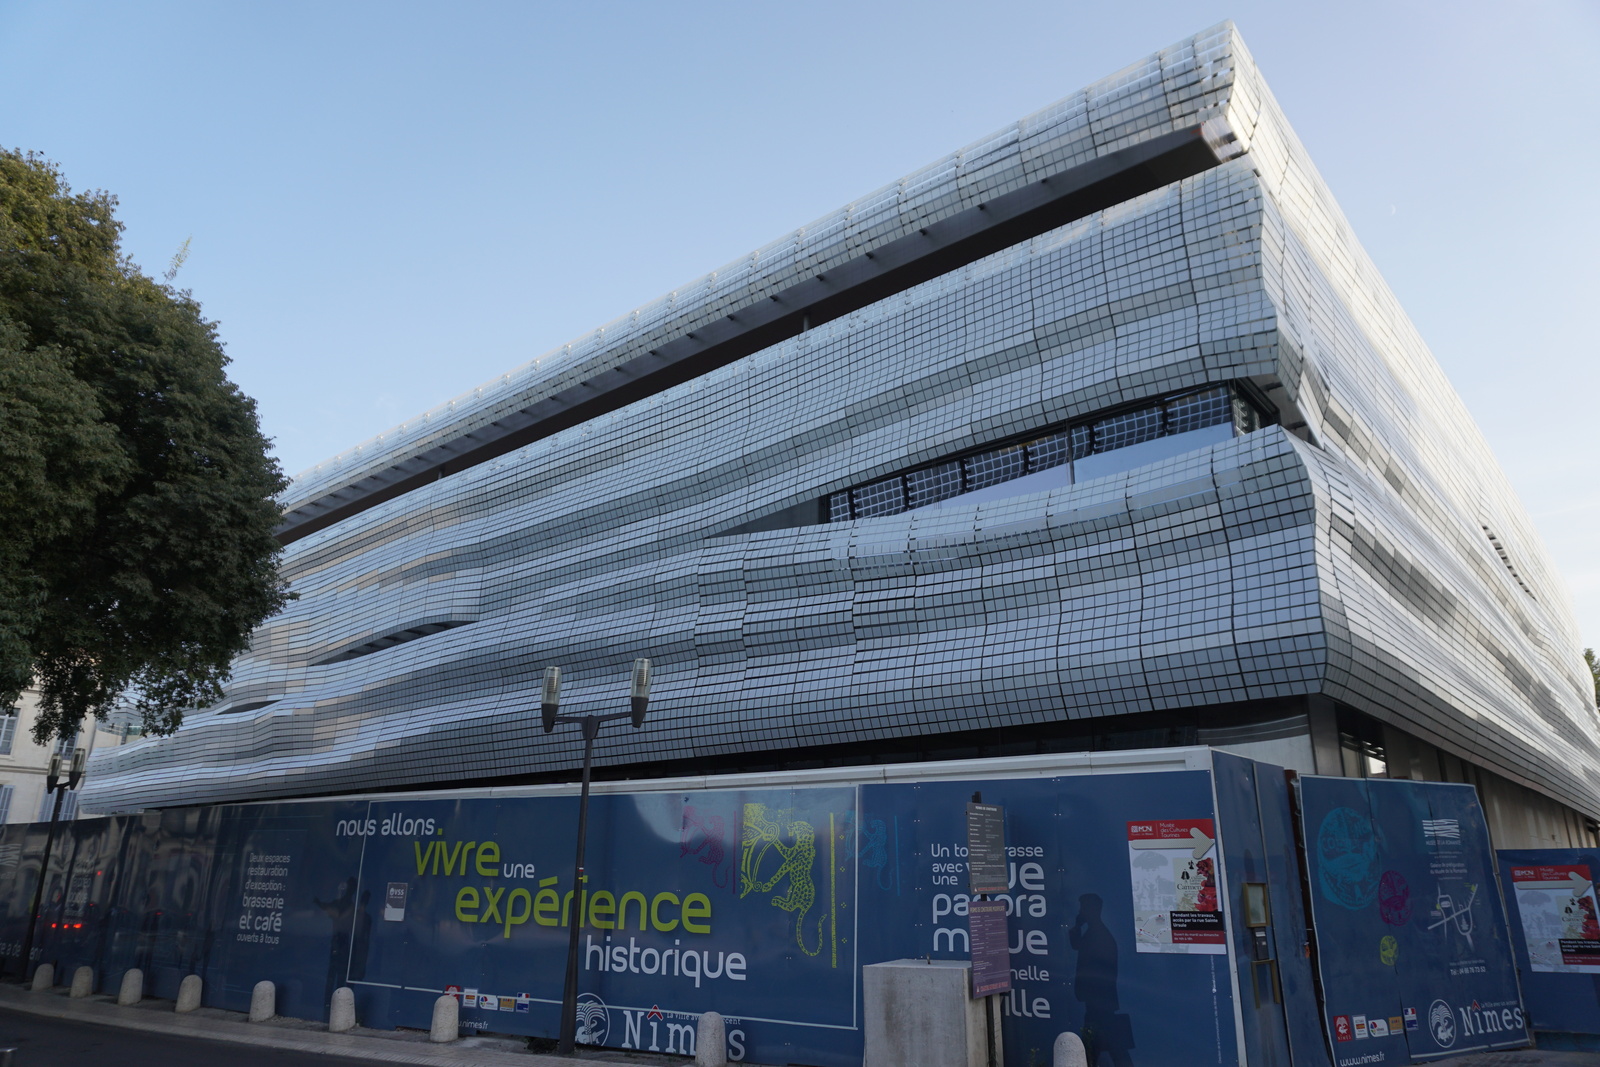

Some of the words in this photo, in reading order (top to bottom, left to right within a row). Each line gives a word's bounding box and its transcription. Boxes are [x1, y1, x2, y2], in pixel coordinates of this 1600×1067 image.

[336, 818, 376, 837] nous
[380, 813, 436, 836] allons
[249, 852, 264, 863] Deux
[265, 855, 290, 864] espaces
[414, 828, 500, 877] vivre
[931, 844, 950, 858] Un
[247, 865, 288, 876] restauration
[504, 862, 535, 879] une
[932, 862, 963, 873] avec
[932, 875, 958, 886] une
[242, 892, 284, 909] brasserie
[455, 875, 712, 938] expérience
[933, 893, 1046, 924] paora
[239, 910, 252, 930] et
[254, 912, 282, 932] café
[236, 932, 258, 942] ouverts
[260, 934, 264, 943] à
[265, 933, 280, 944] tous
[934, 928, 1048, 955] mue
[585, 935, 747, 988] historique
[622, 1004, 745, 1061] Nîms
[1340, 1051, 1384, 1066] www.nimes.fr
